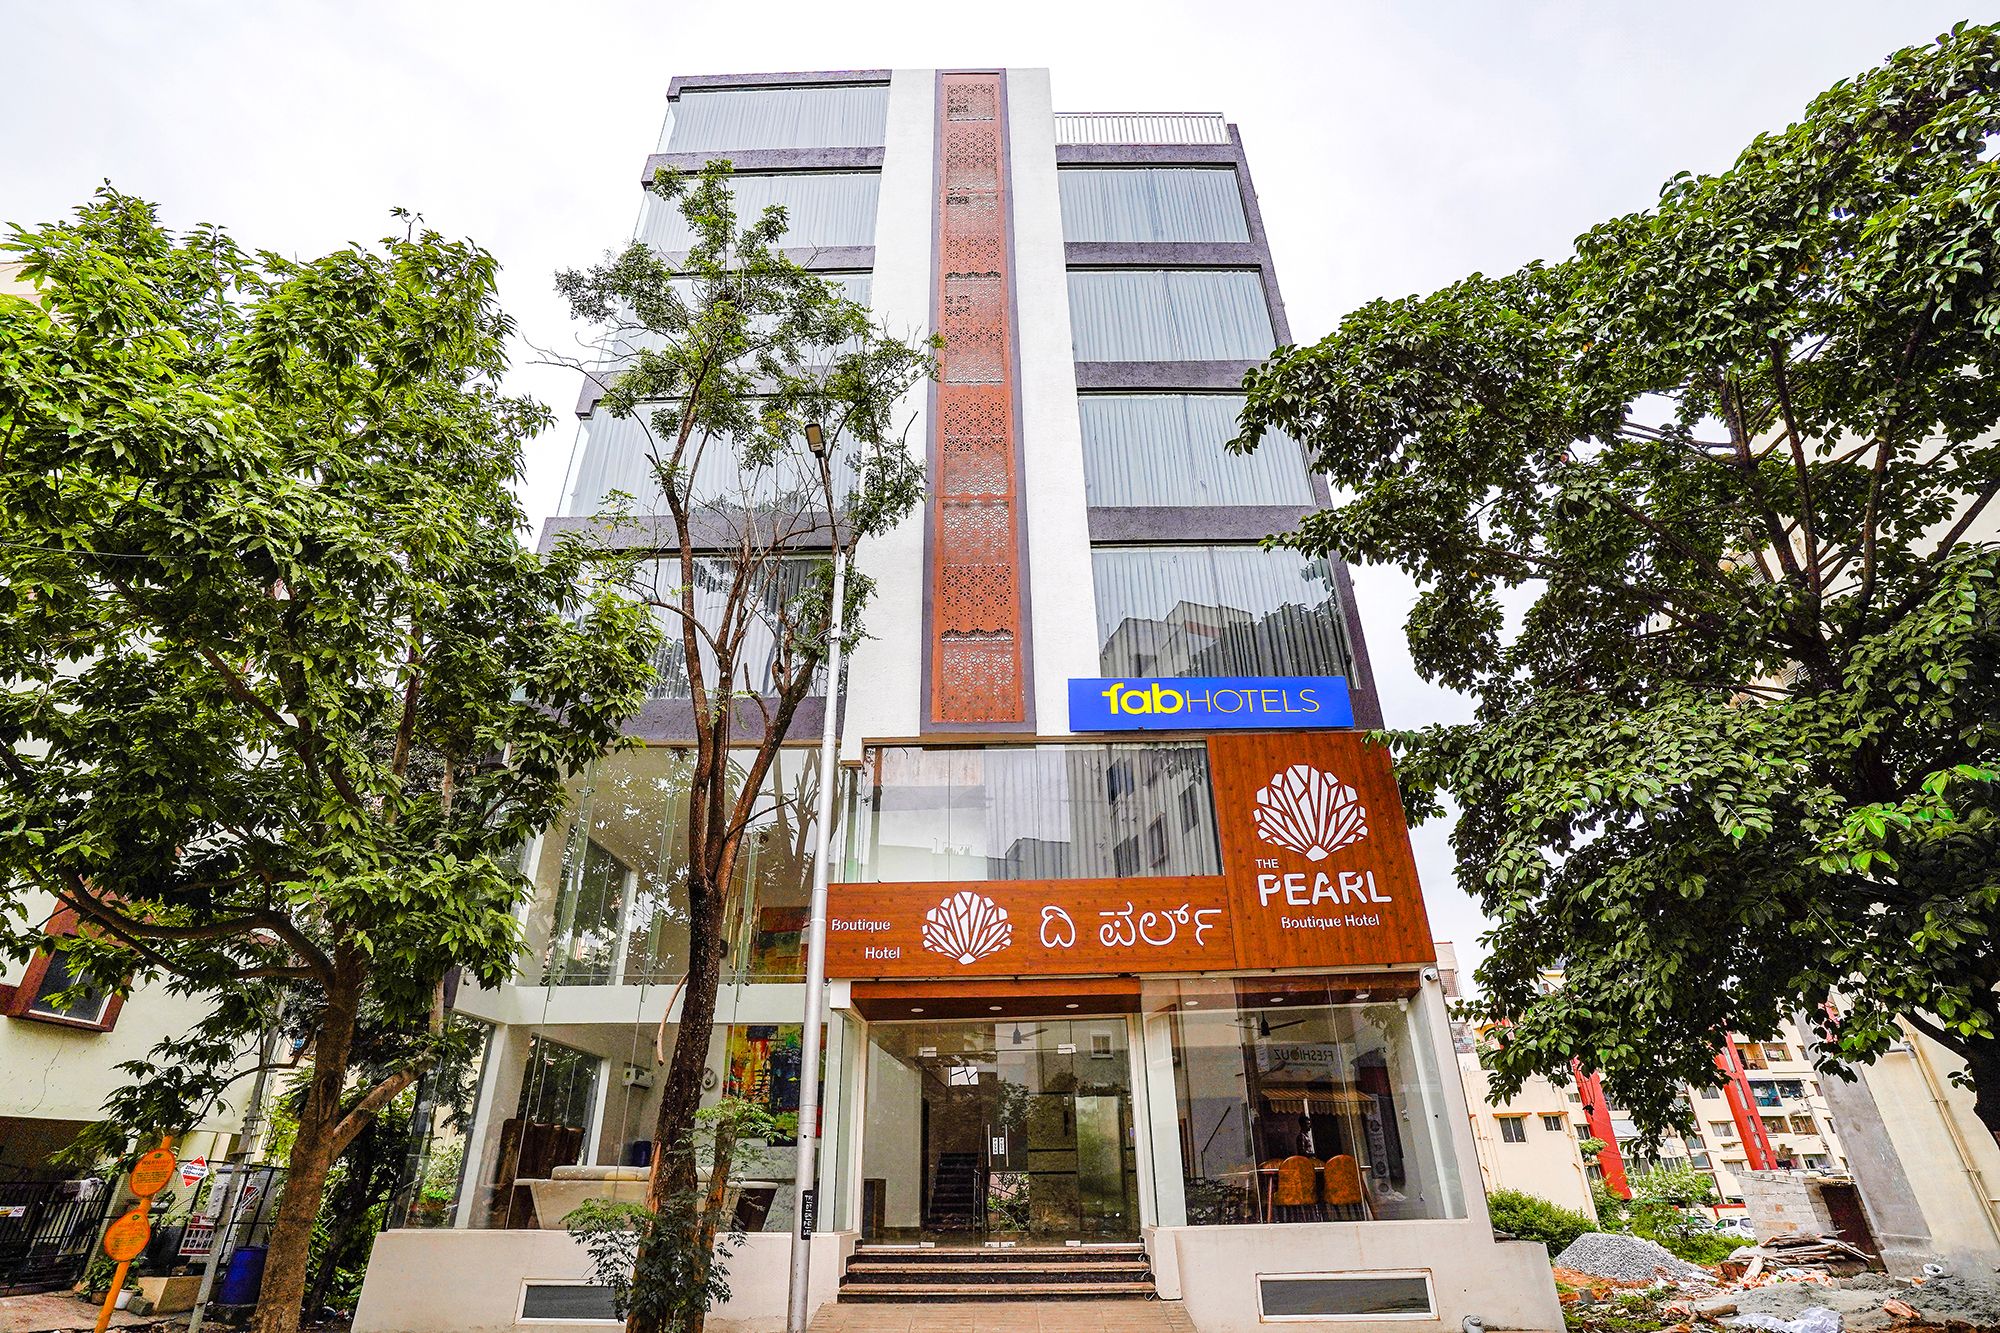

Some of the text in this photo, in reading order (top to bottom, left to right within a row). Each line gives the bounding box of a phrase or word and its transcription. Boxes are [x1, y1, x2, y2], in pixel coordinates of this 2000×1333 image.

[1255, 858, 1279, 868] THE
[1257, 870, 1392, 906] PEARL
[831, 918, 891, 933] Boutique
[1040, 905, 1076, 948] ದಿ
[1281, 914, 1380, 930] Boutique Hotel
[865, 946, 900, 959] Hotel
